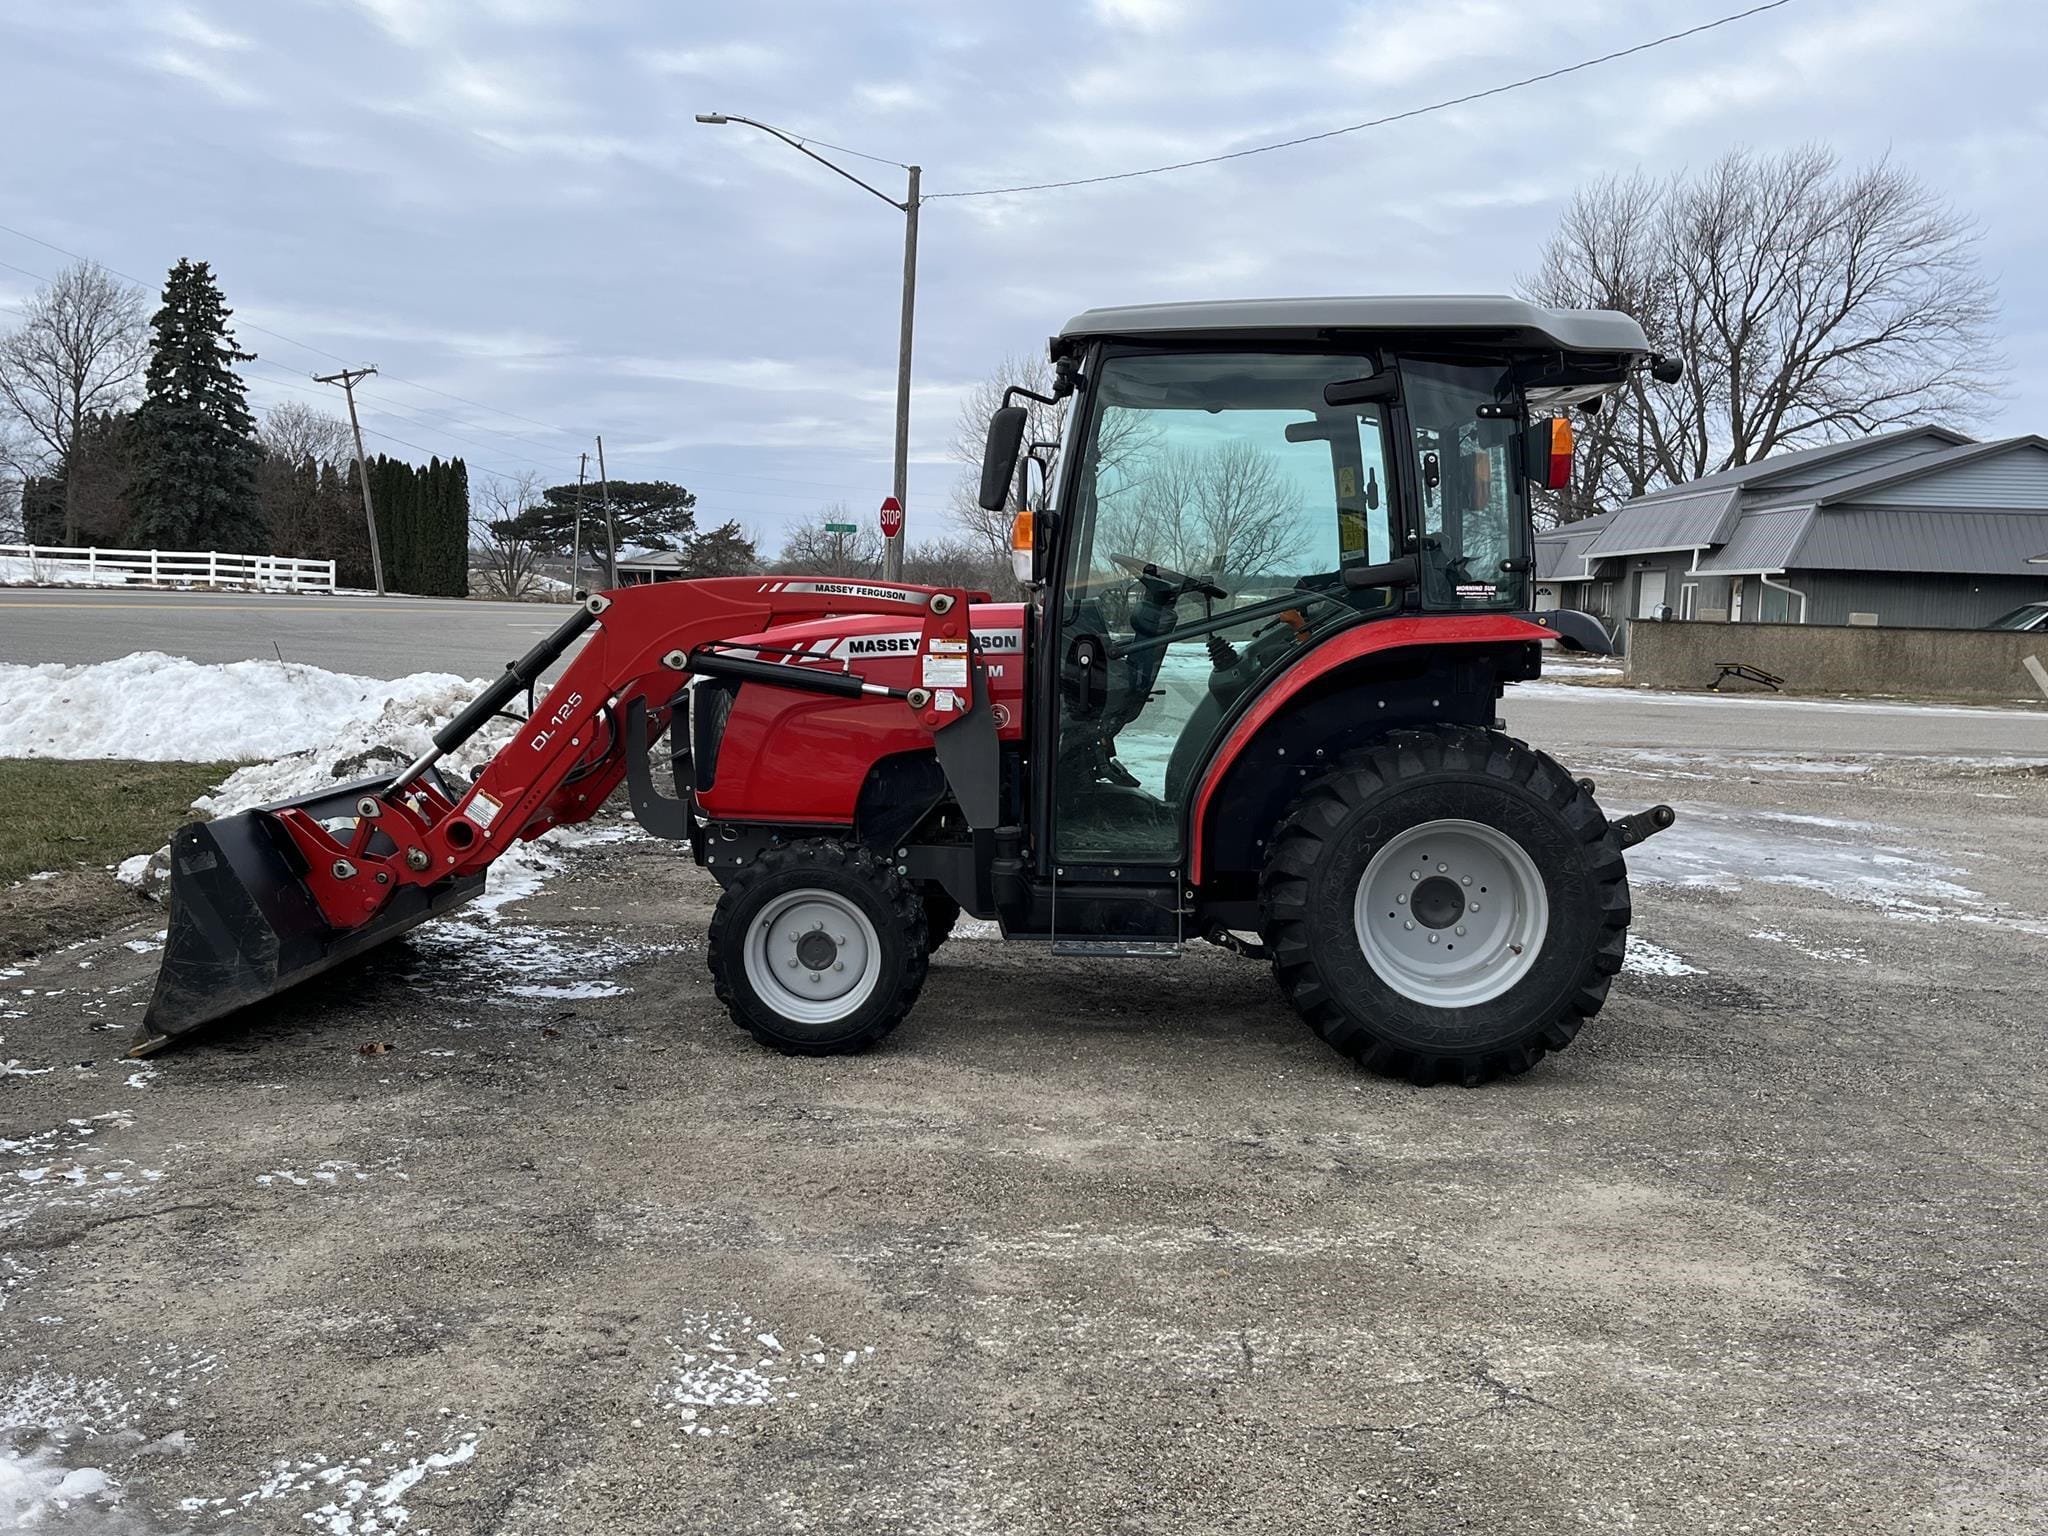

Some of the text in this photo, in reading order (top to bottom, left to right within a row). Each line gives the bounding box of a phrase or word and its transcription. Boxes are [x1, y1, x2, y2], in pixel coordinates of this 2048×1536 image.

[881, 510, 901, 525] STOP
[815, 584, 906, 601] MASSEY FERGUSON
[849, 638, 920, 653] MASSEY
